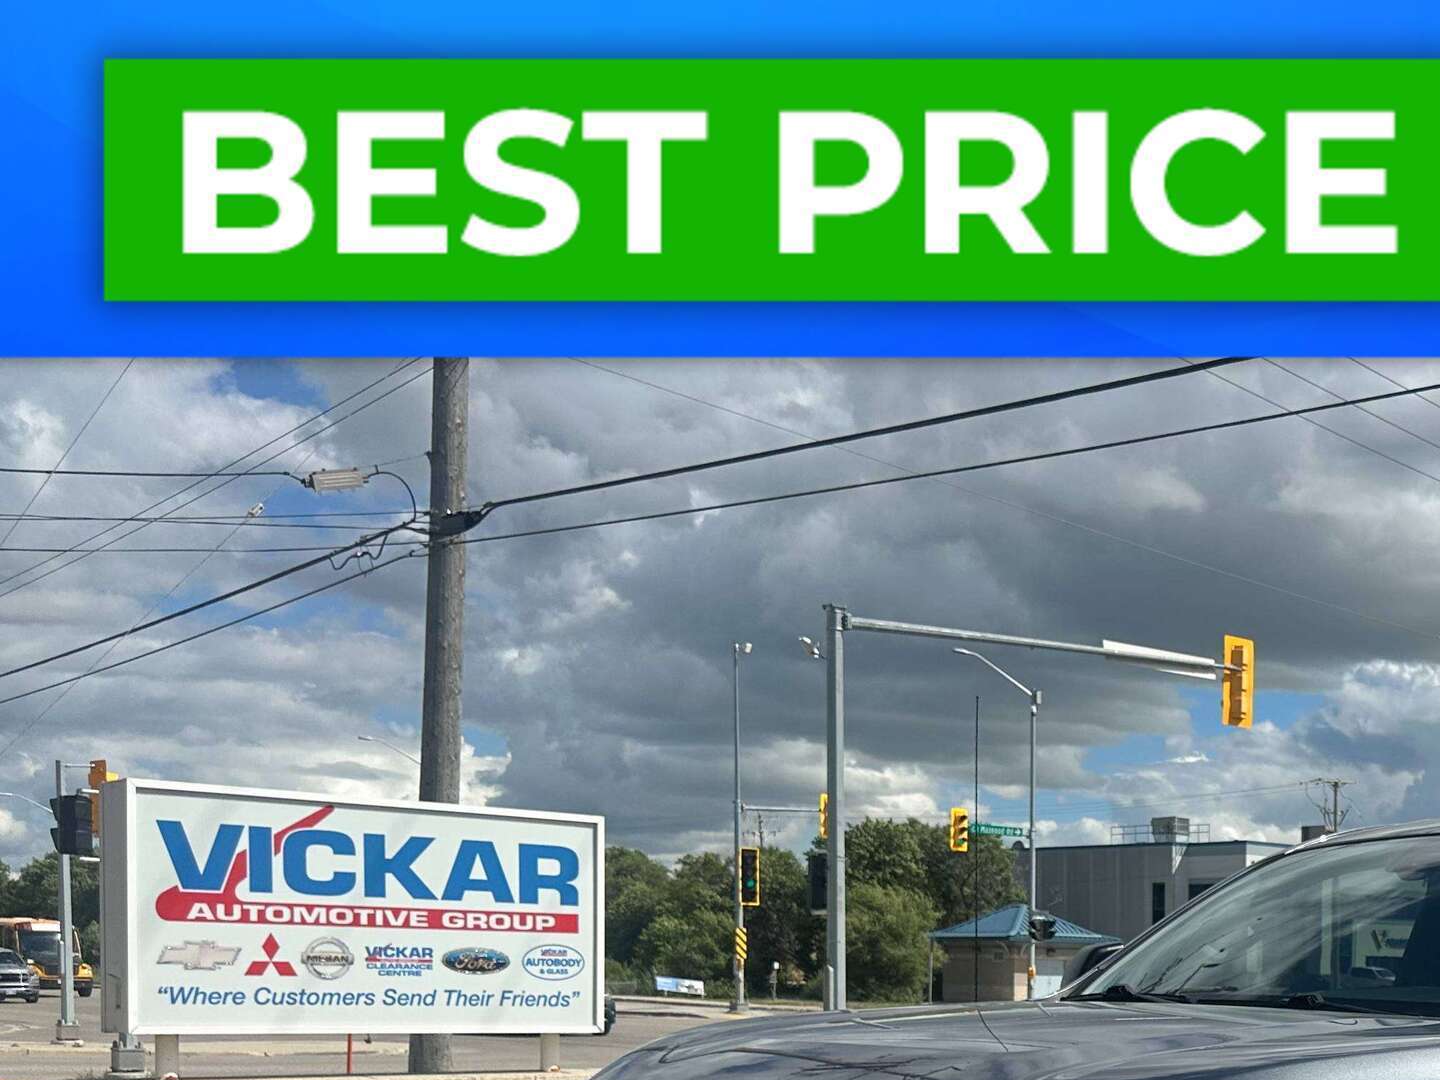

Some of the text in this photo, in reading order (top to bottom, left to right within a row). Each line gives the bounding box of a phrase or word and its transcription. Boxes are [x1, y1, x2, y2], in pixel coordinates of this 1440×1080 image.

[157, 820, 579, 906] VICKAR
[187, 902, 555, 931] AUTOMOTIVE GROUP
[365, 945, 433, 958] VICKAR
[454, 952, 497, 971] Ford
[526, 958, 581, 967] AUTOBODY
[253, 987, 376, 1006] Customers
[382, 988, 437, 1007] Send
[444, 989, 494, 1007] Their
